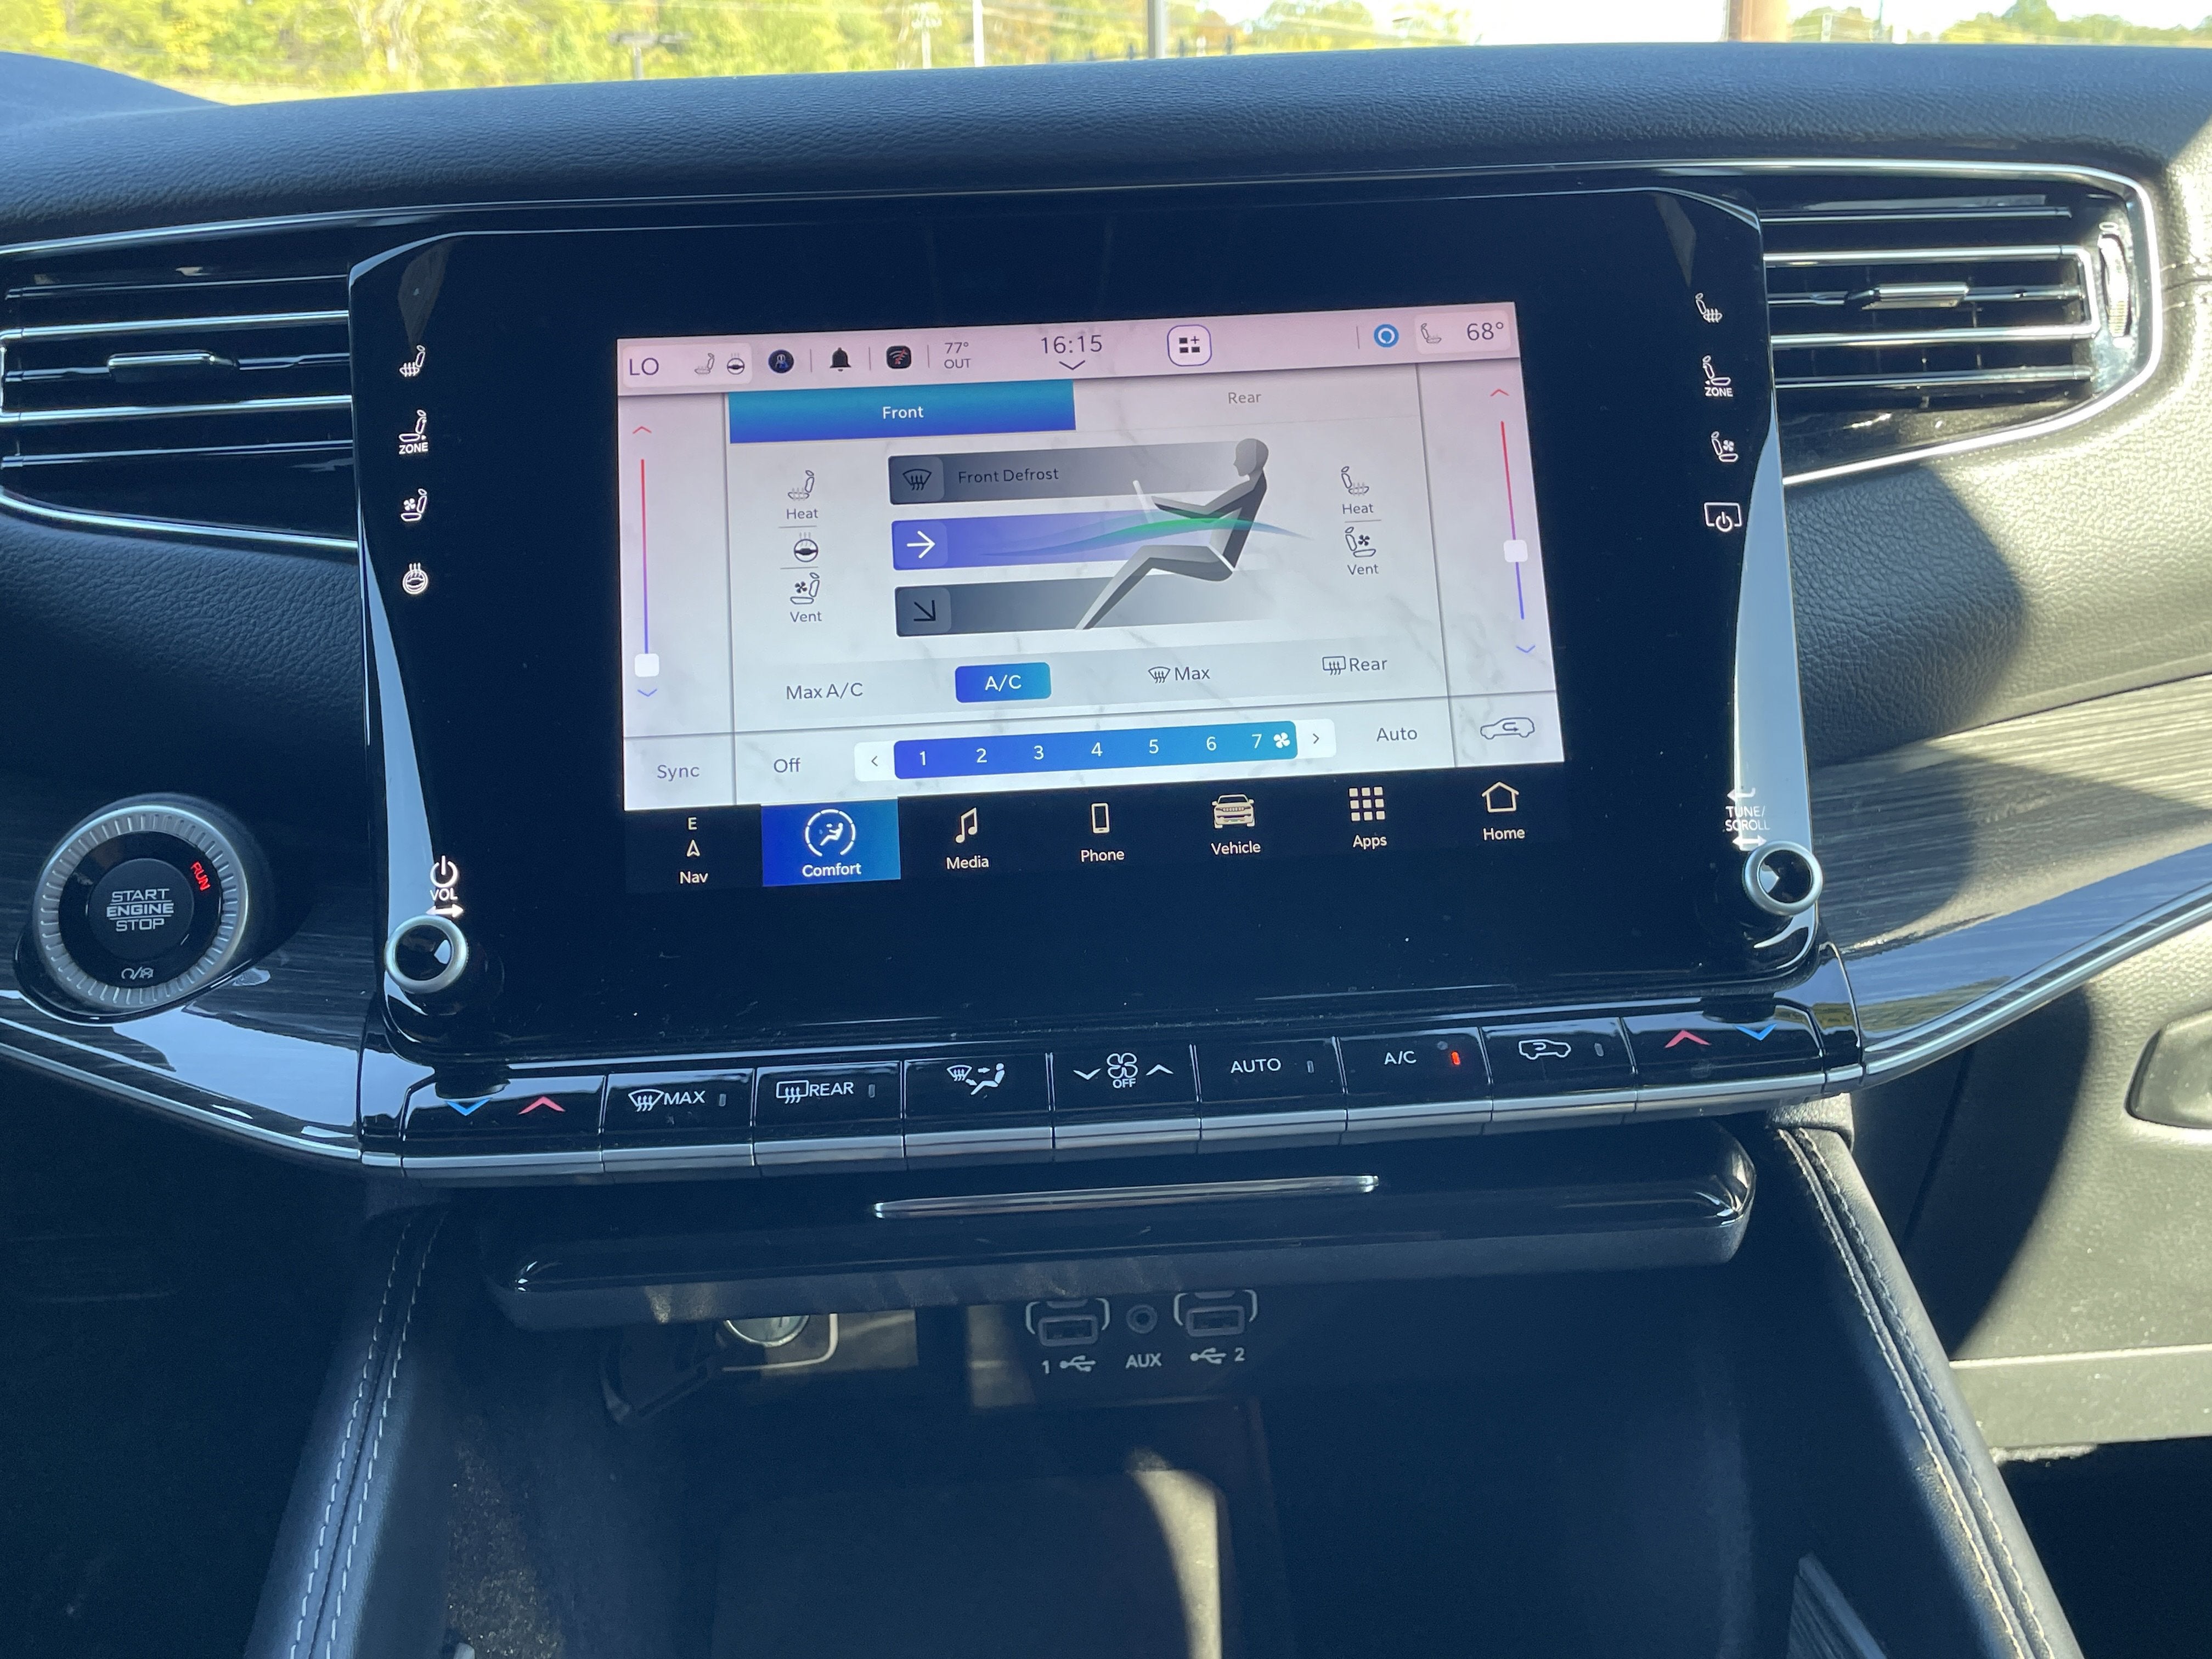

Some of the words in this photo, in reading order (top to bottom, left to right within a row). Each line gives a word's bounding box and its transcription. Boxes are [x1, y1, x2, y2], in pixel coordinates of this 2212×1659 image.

[1041, 335, 1103, 354] 16:15
[629, 358, 659, 376] LO
[944, 358, 972, 369] OUT
[1228, 391, 1262, 404] Rear
[1705, 387, 1733, 397] ZONE
[882, 406, 924, 420] Front
[399, 442, 428, 455] ZONE
[958, 471, 1000, 483] Front
[1003, 467, 1059, 482] Defrost
[786, 508, 819, 520] Heat
[1342, 503, 1374, 515] Heat
[1347, 563, 1379, 575] Vent
[790, 611, 822, 623] Vent
[1350, 657, 1387, 672] Rear
[1174, 666, 1210, 681] Max
[985, 675, 1022, 691] A/C
[786, 685, 822, 700] Max
[826, 682, 864, 698] A/C
[1376, 727, 1418, 742] Auto
[919, 751, 927, 766] 1
[976, 748, 988, 763] 2
[1034, 746, 1044, 760] 3
[1091, 742, 1103, 758] 4
[1149, 740, 1159, 754] 5
[1206, 736, 1217, 751] 6
[1251, 734, 1262, 749] 7
[657, 764, 700, 781] Sync
[774, 758, 801, 774] Off
[1725, 805, 1765, 817] TUNE/
[688, 817, 697, 830] E
[1725, 819, 1770, 832] SCROLL
[1483, 827, 1525, 840] Home
[1211, 841, 1261, 856] Vehicle
[1352, 834, 1387, 849] Apps
[1080, 849, 1125, 862] Phone
[802, 863, 862, 877] Comfort
[946, 856, 989, 870] Media
[190, 861, 211, 891] RUN
[679, 871, 708, 884] Nav
[112, 888, 170, 902] START
[430, 888, 458, 901] VOL
[106, 902, 174, 917] ENGINE
[116, 918, 165, 932] STOP
[1384, 1051, 1417, 1065] A/C
[1231, 1058, 1282, 1073] AUTO
[809, 1082, 854, 1097] REAR
[1112, 1077, 1136, 1088] OFF
[663, 1090, 706, 1105] MAX
[1126, 1353, 1162, 1368] AUX
[1234, 1347, 1245, 1362] 2
[1042, 1360, 1049, 1374] 1
